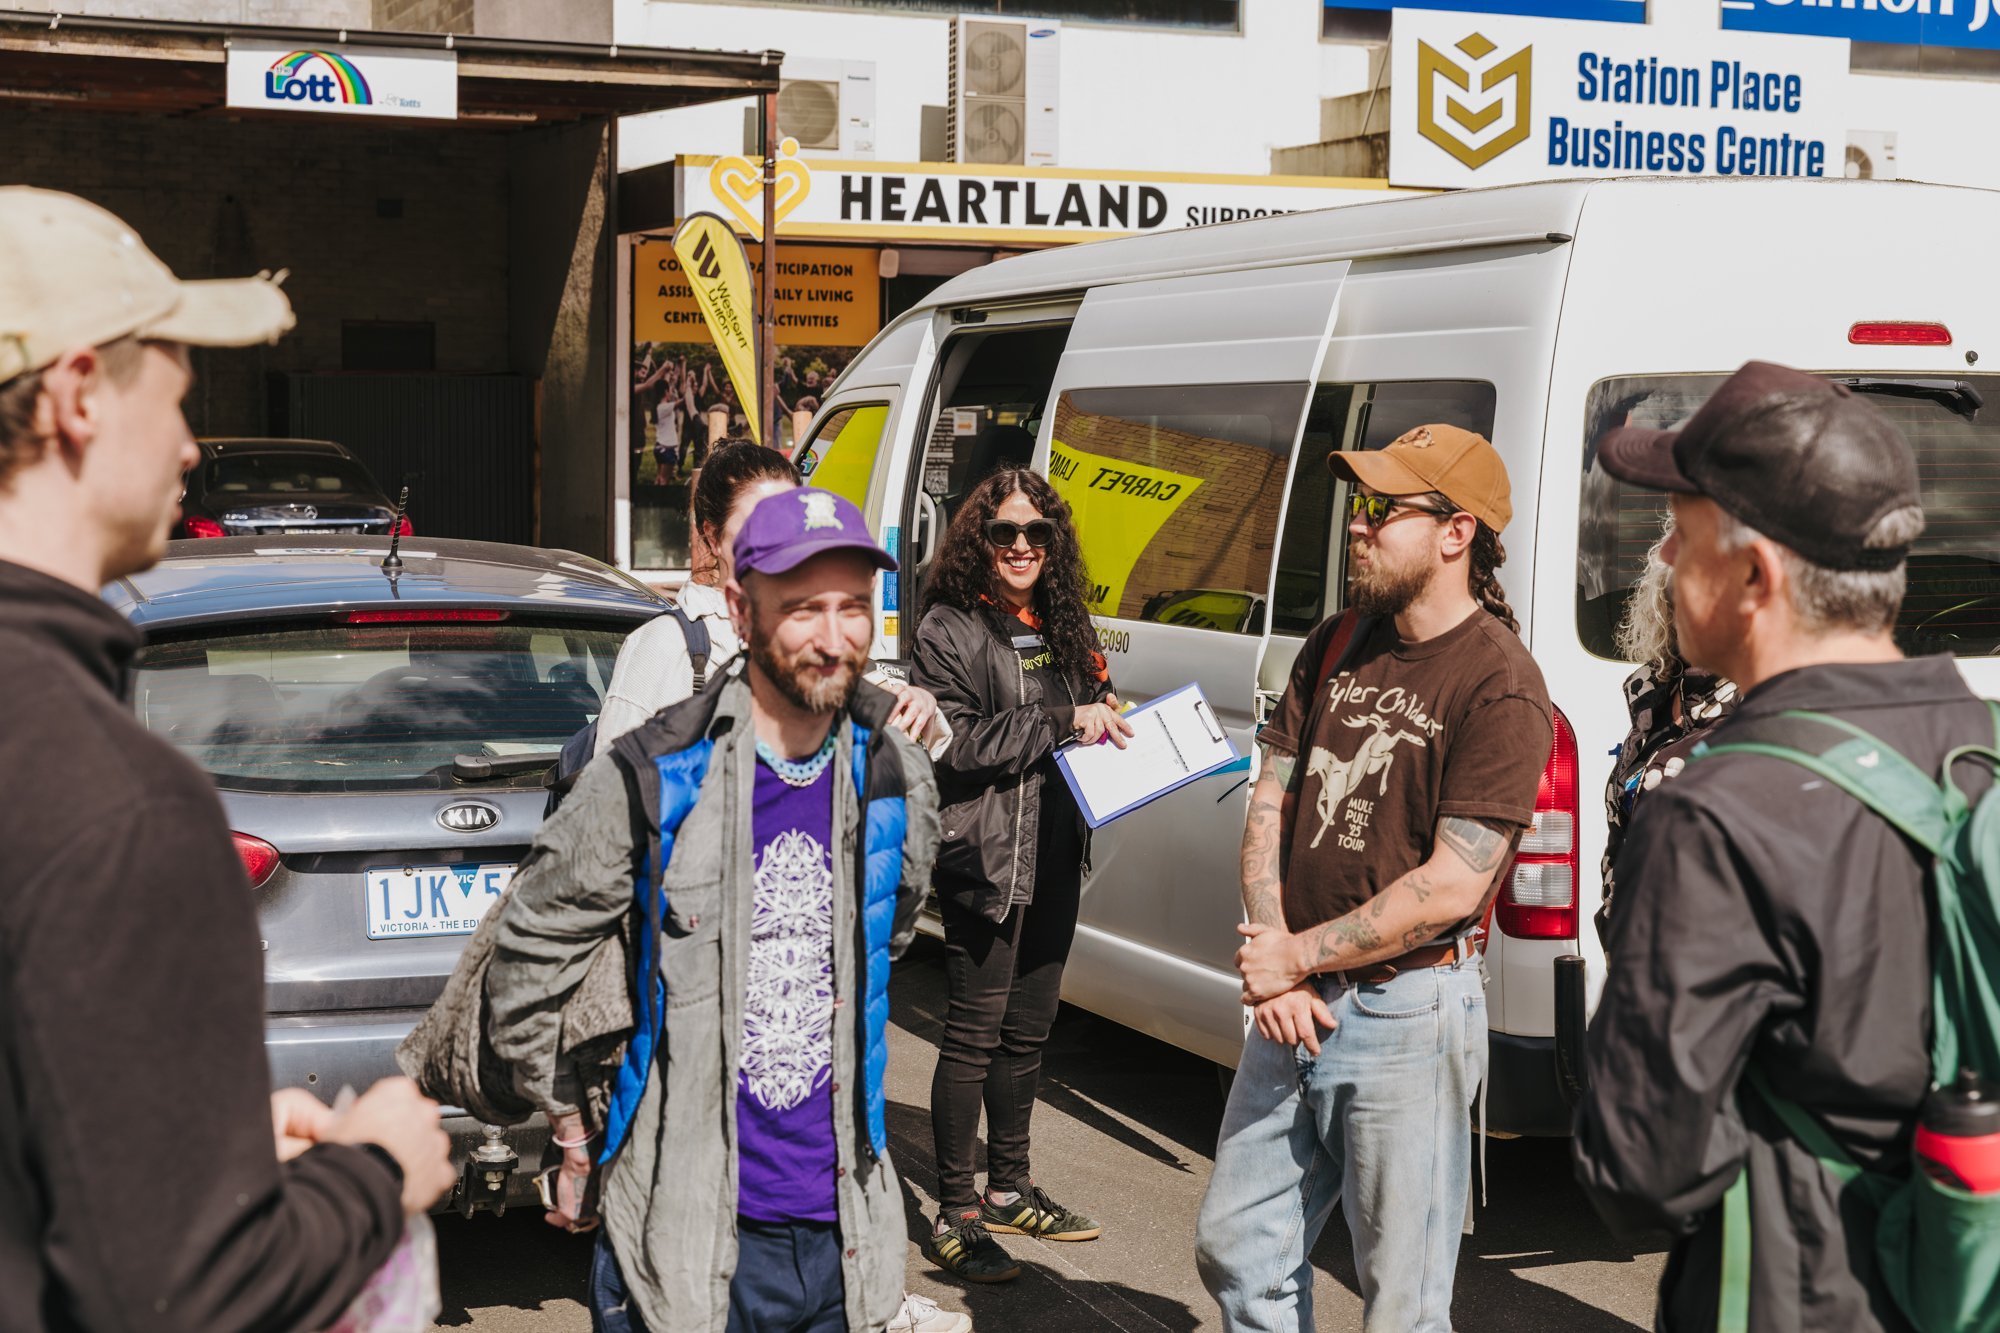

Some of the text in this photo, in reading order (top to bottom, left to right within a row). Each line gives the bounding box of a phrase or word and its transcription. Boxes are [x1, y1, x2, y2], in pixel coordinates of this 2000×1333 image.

[265, 70, 336, 103] Lott
[1577, 51, 1801, 113] Station Place
[1547, 116, 1825, 177] Business Centre
[840, 175, 1169, 229] HEARTLAND
[749, 261, 854, 277] PATICIPATION
[773, 288, 803, 302] AILY
[807, 289, 854, 303] LIVING
[708, 288, 731, 337] Union
[716, 280, 748, 349] Western
[1347, 797, 1375, 815] MULE
[447, 807, 492, 826] KIA
[1344, 812, 1370, 828] PULL
[1348, 823, 1362, 838] '25
[1337, 834, 1366, 853] TOUR
[457, 874, 476, 884] VIC
[380, 922, 429, 933] VICTORIA
[439, 920, 460, 930] THE
